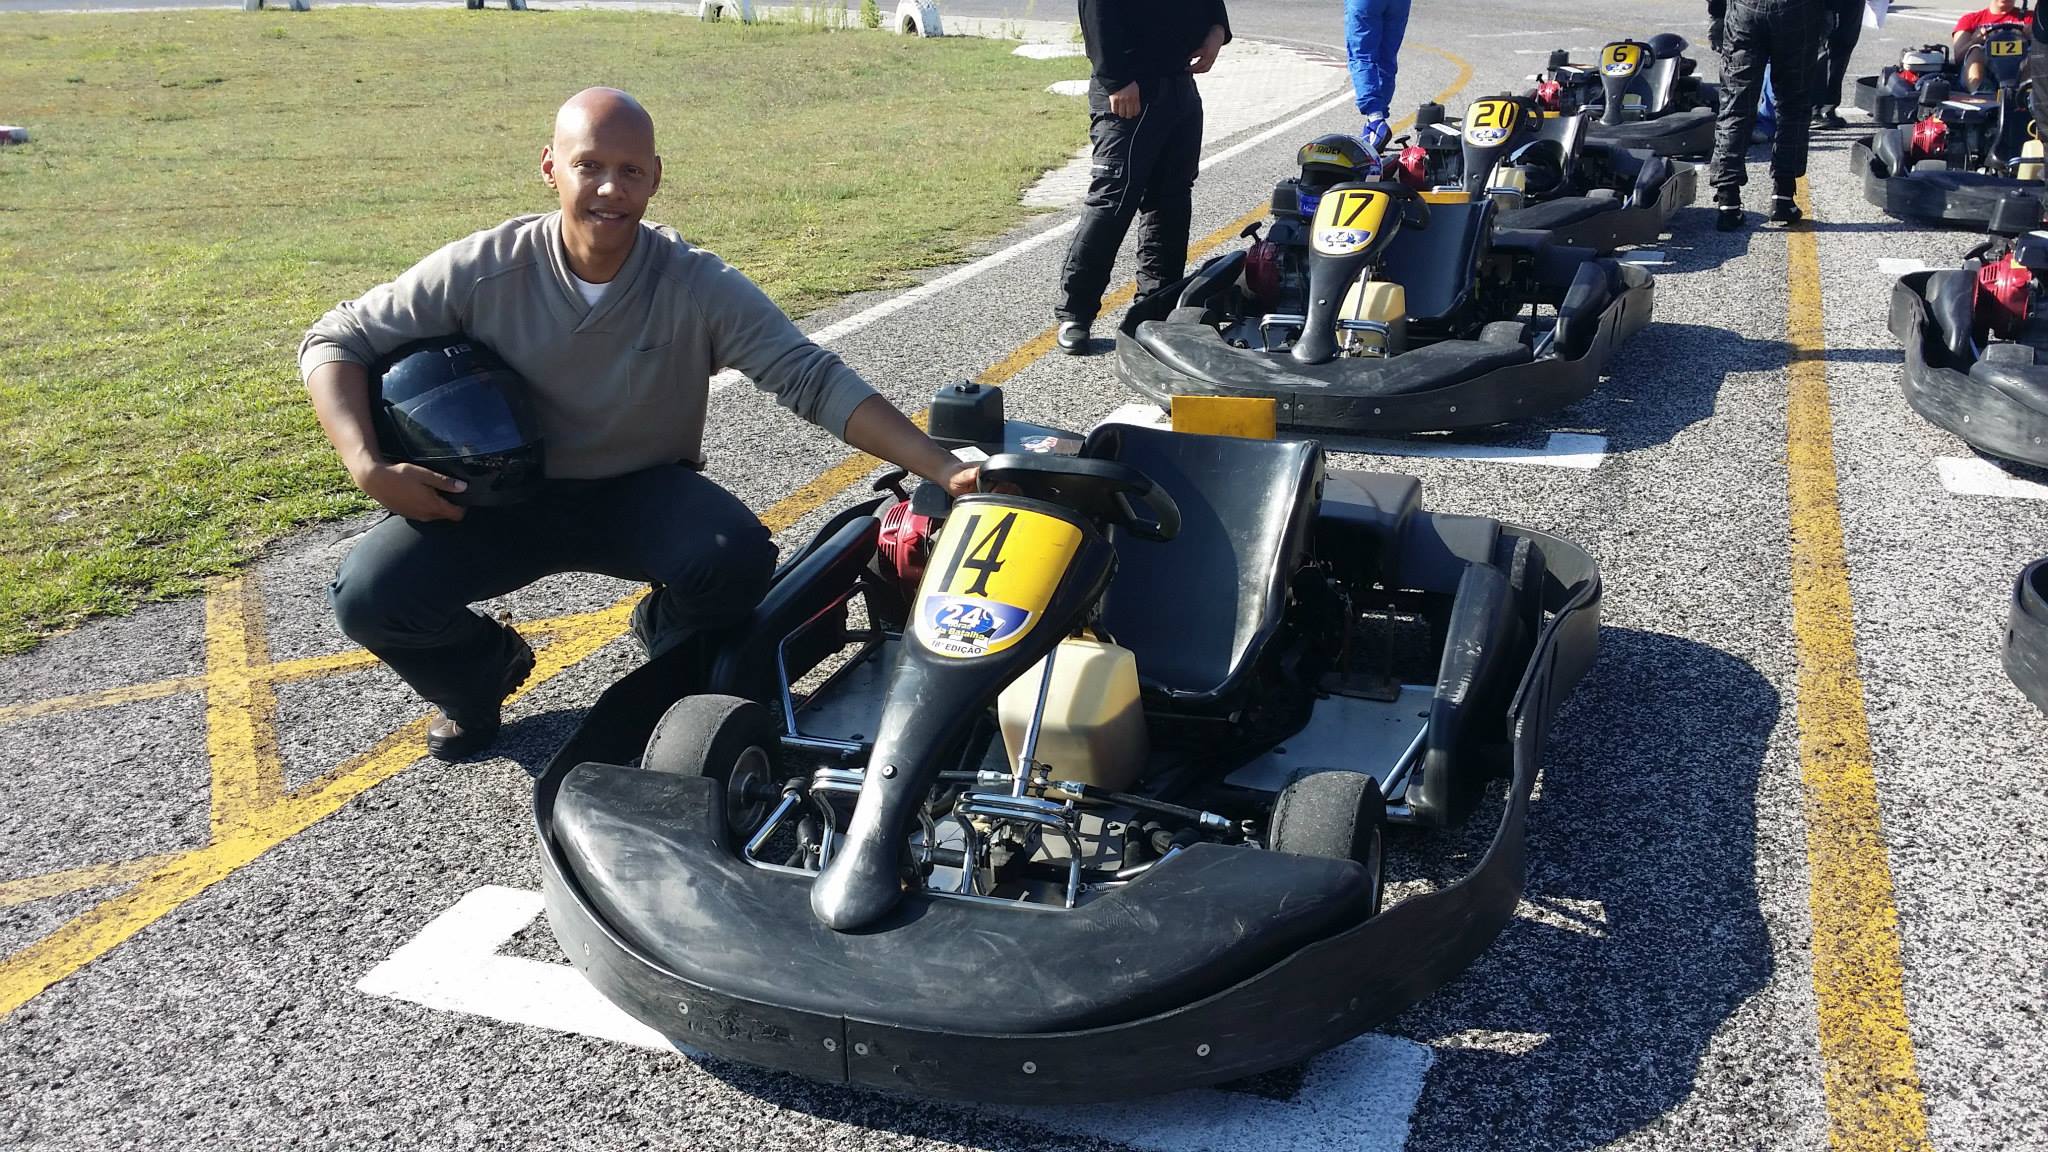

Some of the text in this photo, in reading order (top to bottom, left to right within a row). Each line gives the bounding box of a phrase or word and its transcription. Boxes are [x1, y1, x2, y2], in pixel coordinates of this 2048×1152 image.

[1613, 46, 1628, 62] 6
[1474, 102, 1515, 129] 20
[1332, 193, 1375, 226] 17
[938, 512, 1018, 597] 14
[940, 604, 981, 628] 24
[948, 628, 985, 640] Batalha
[945, 643, 982, 654] EDIÇÃO
